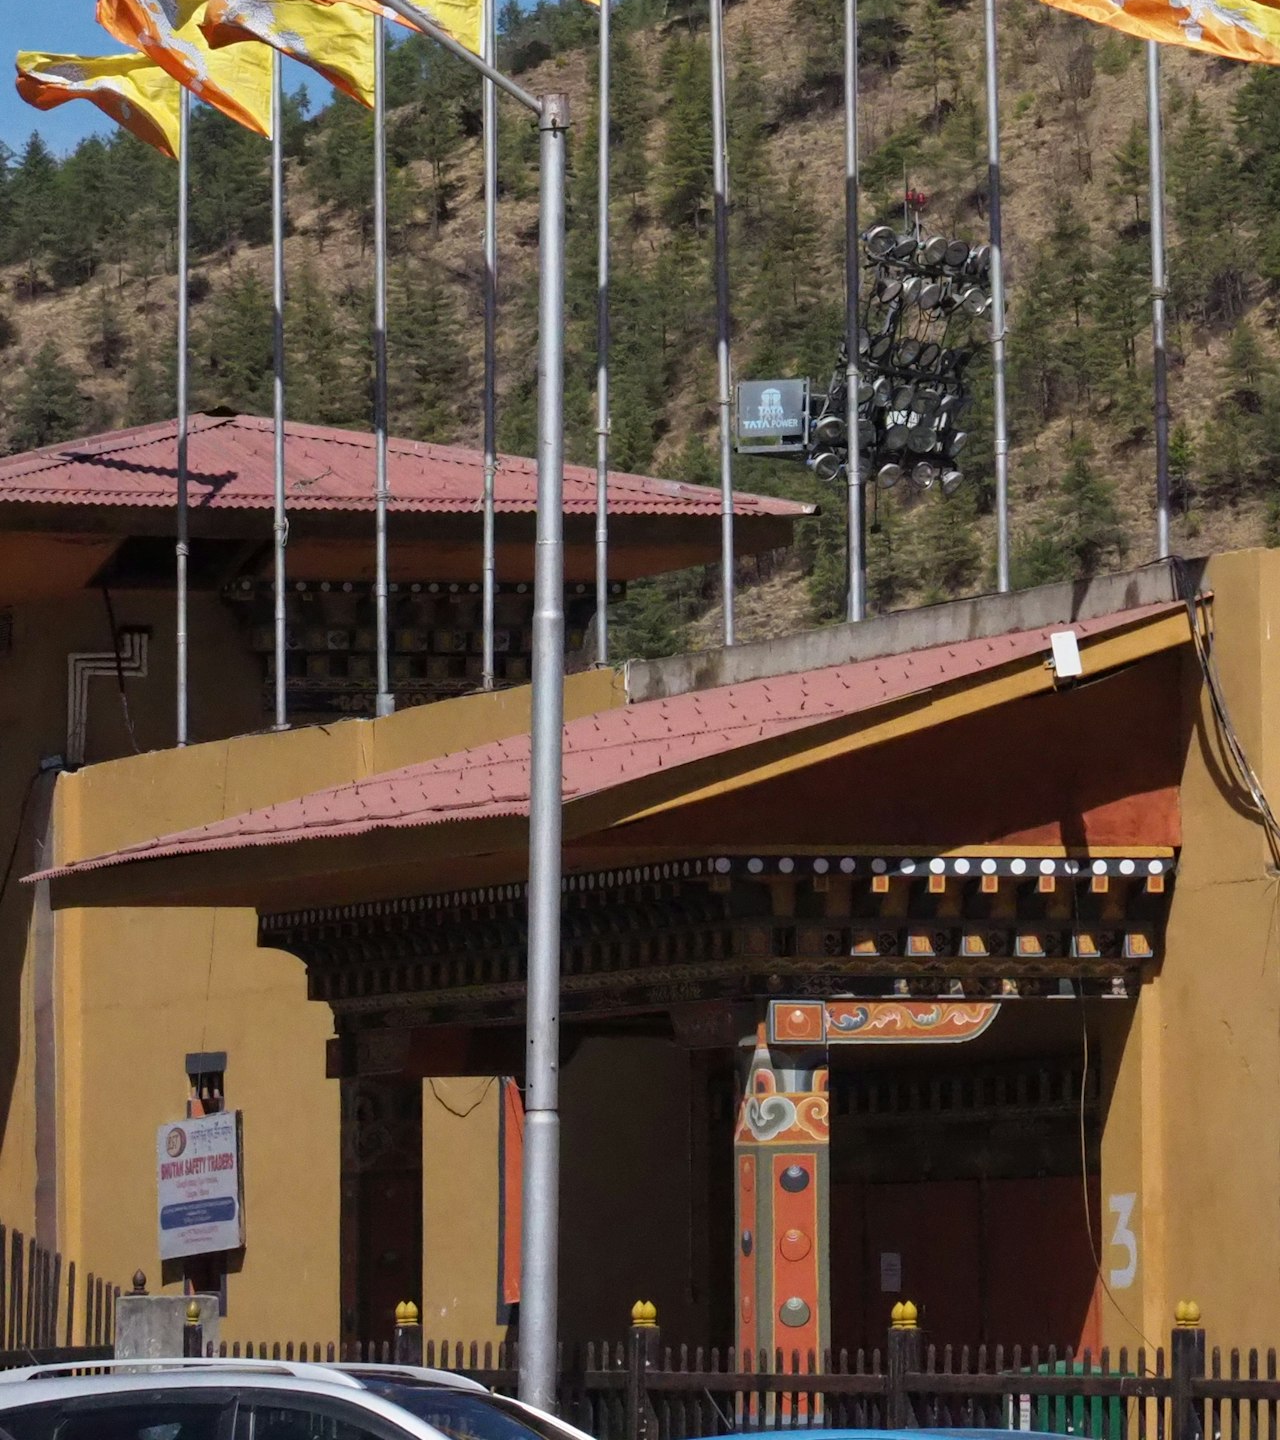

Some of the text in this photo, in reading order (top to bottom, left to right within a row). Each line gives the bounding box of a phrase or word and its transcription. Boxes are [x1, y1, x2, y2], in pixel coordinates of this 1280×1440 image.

[743, 419, 798, 429] TATA POWER
[161, 1153, 233, 1180] BHUTAN SAFETY TRADERS
[1108, 1192, 1138, 1289] 3
